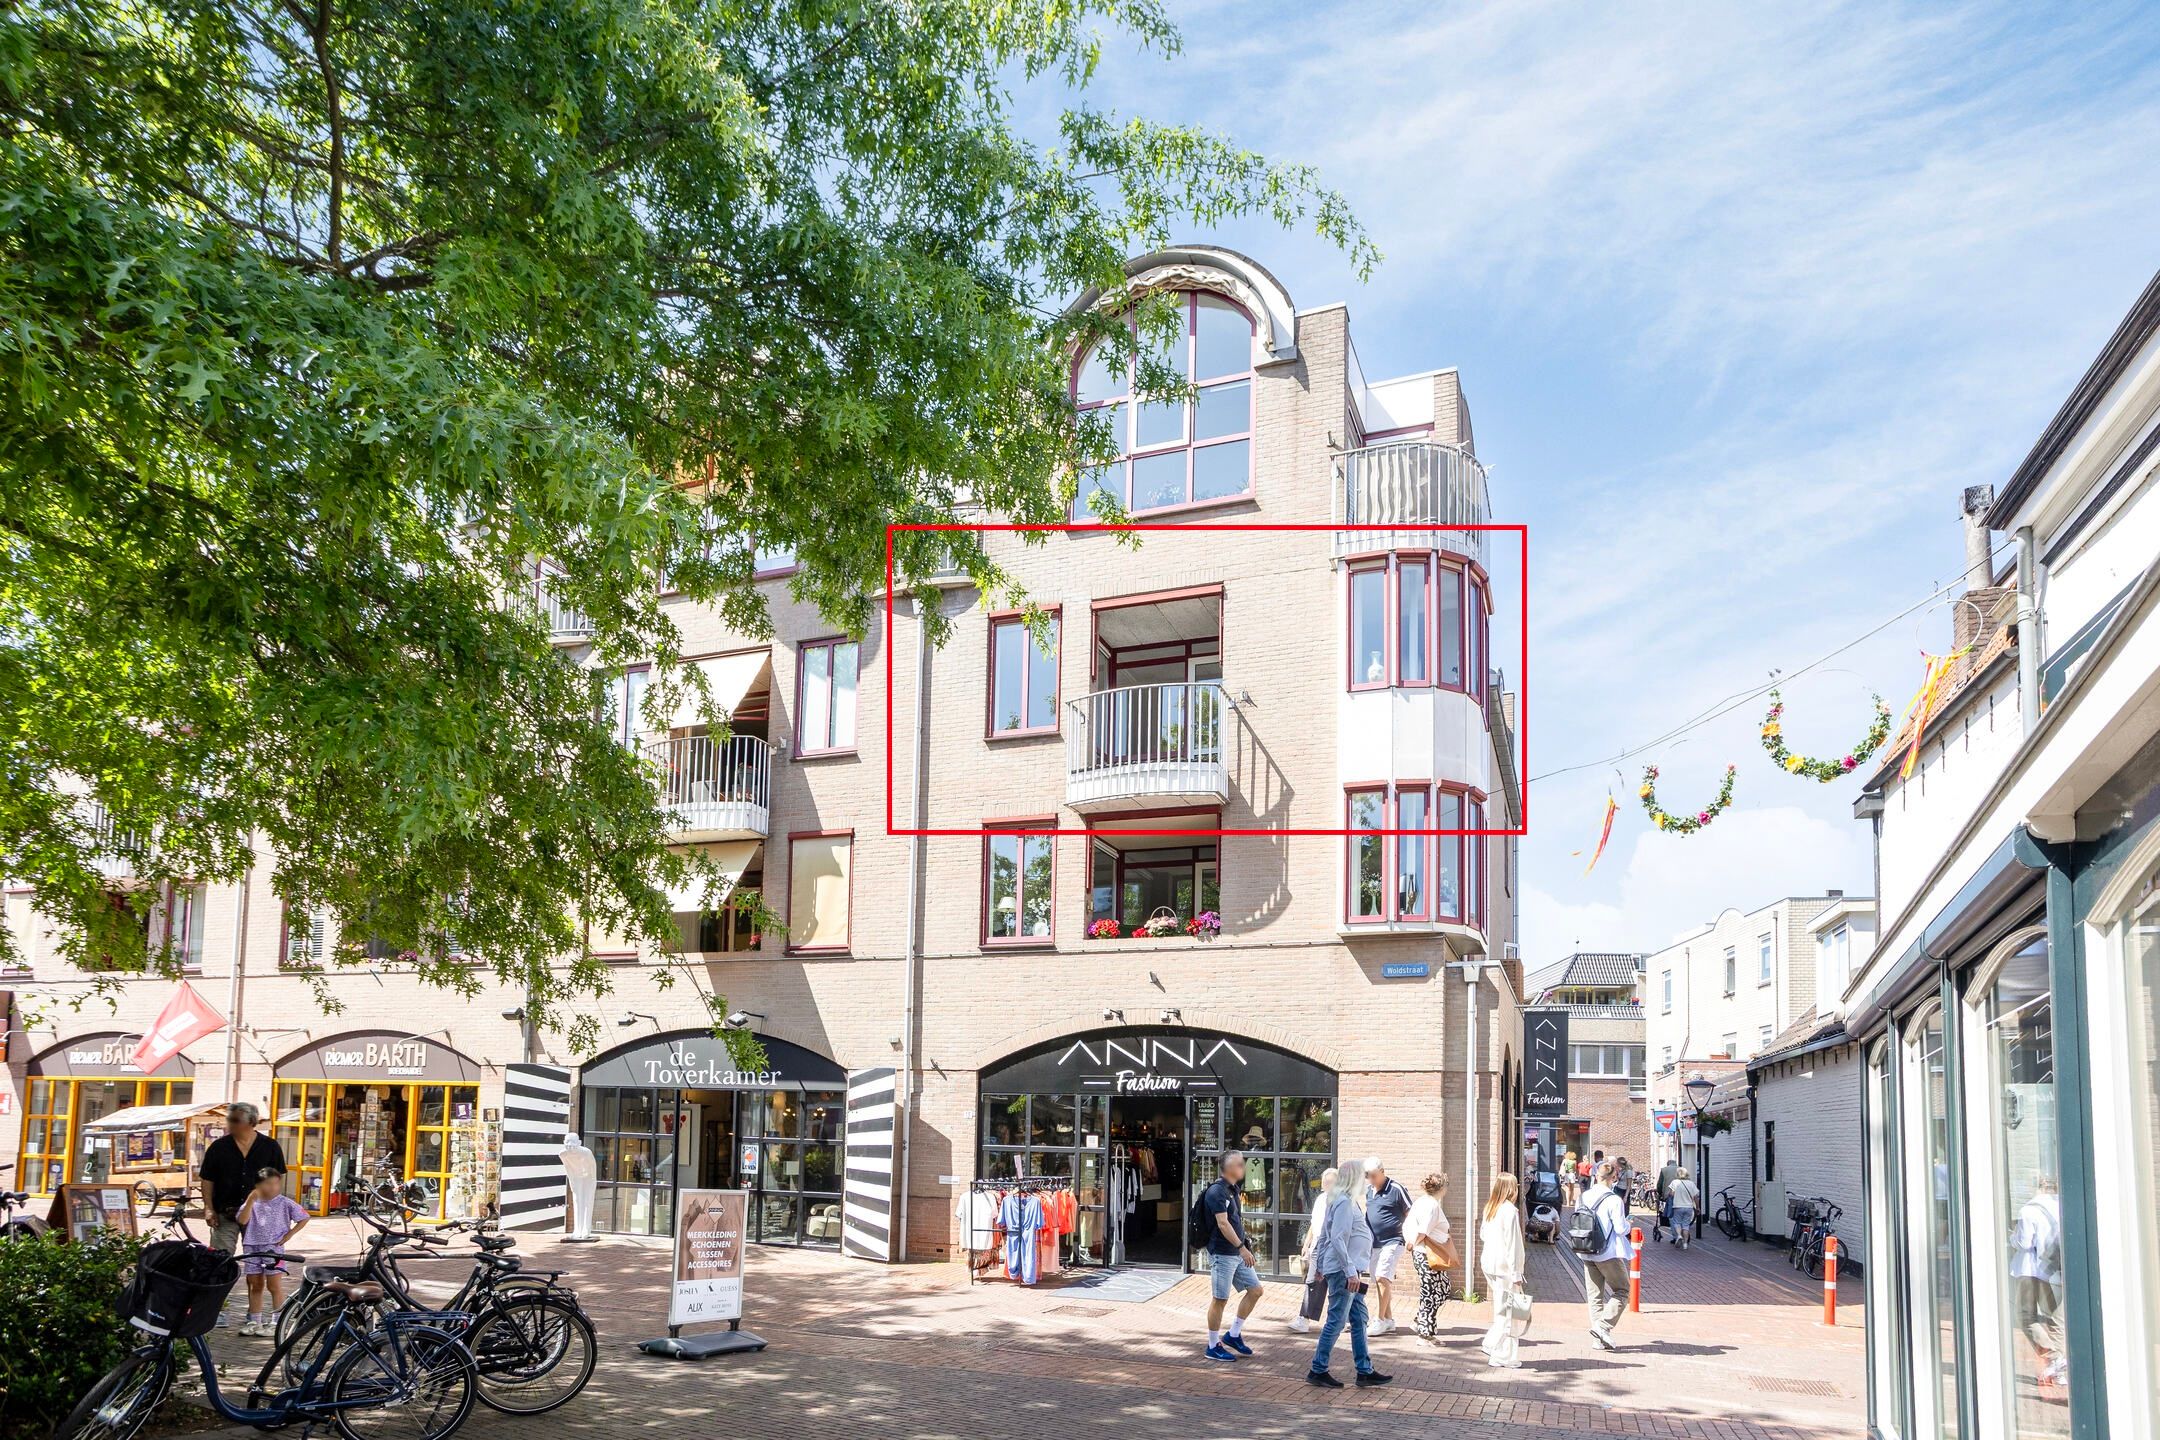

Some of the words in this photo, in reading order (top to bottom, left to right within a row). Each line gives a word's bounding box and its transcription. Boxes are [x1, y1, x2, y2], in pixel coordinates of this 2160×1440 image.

[1386, 966, 1424, 974] Woldstraat
[103, 1043, 139, 1065] BAR
[365, 1043, 427, 1067] BARTH
[669, 1042, 696, 1067] de
[1058, 1038, 1247, 1069] ANNA
[644, 1060, 781, 1086] Toverkamer
[1115, 1070, 1181, 1092] Fashion
[1526, 1092, 1566, 1105] Fashion
[687, 1230, 737, 1239] MERKKLEDING
[692, 1240, 731, 1249] SCHOENEN
[697, 1250, 724, 1258] TASSEN
[688, 1259, 732, 1269] ACCESSOIRES
[687, 1302, 704, 1313] ALIX
